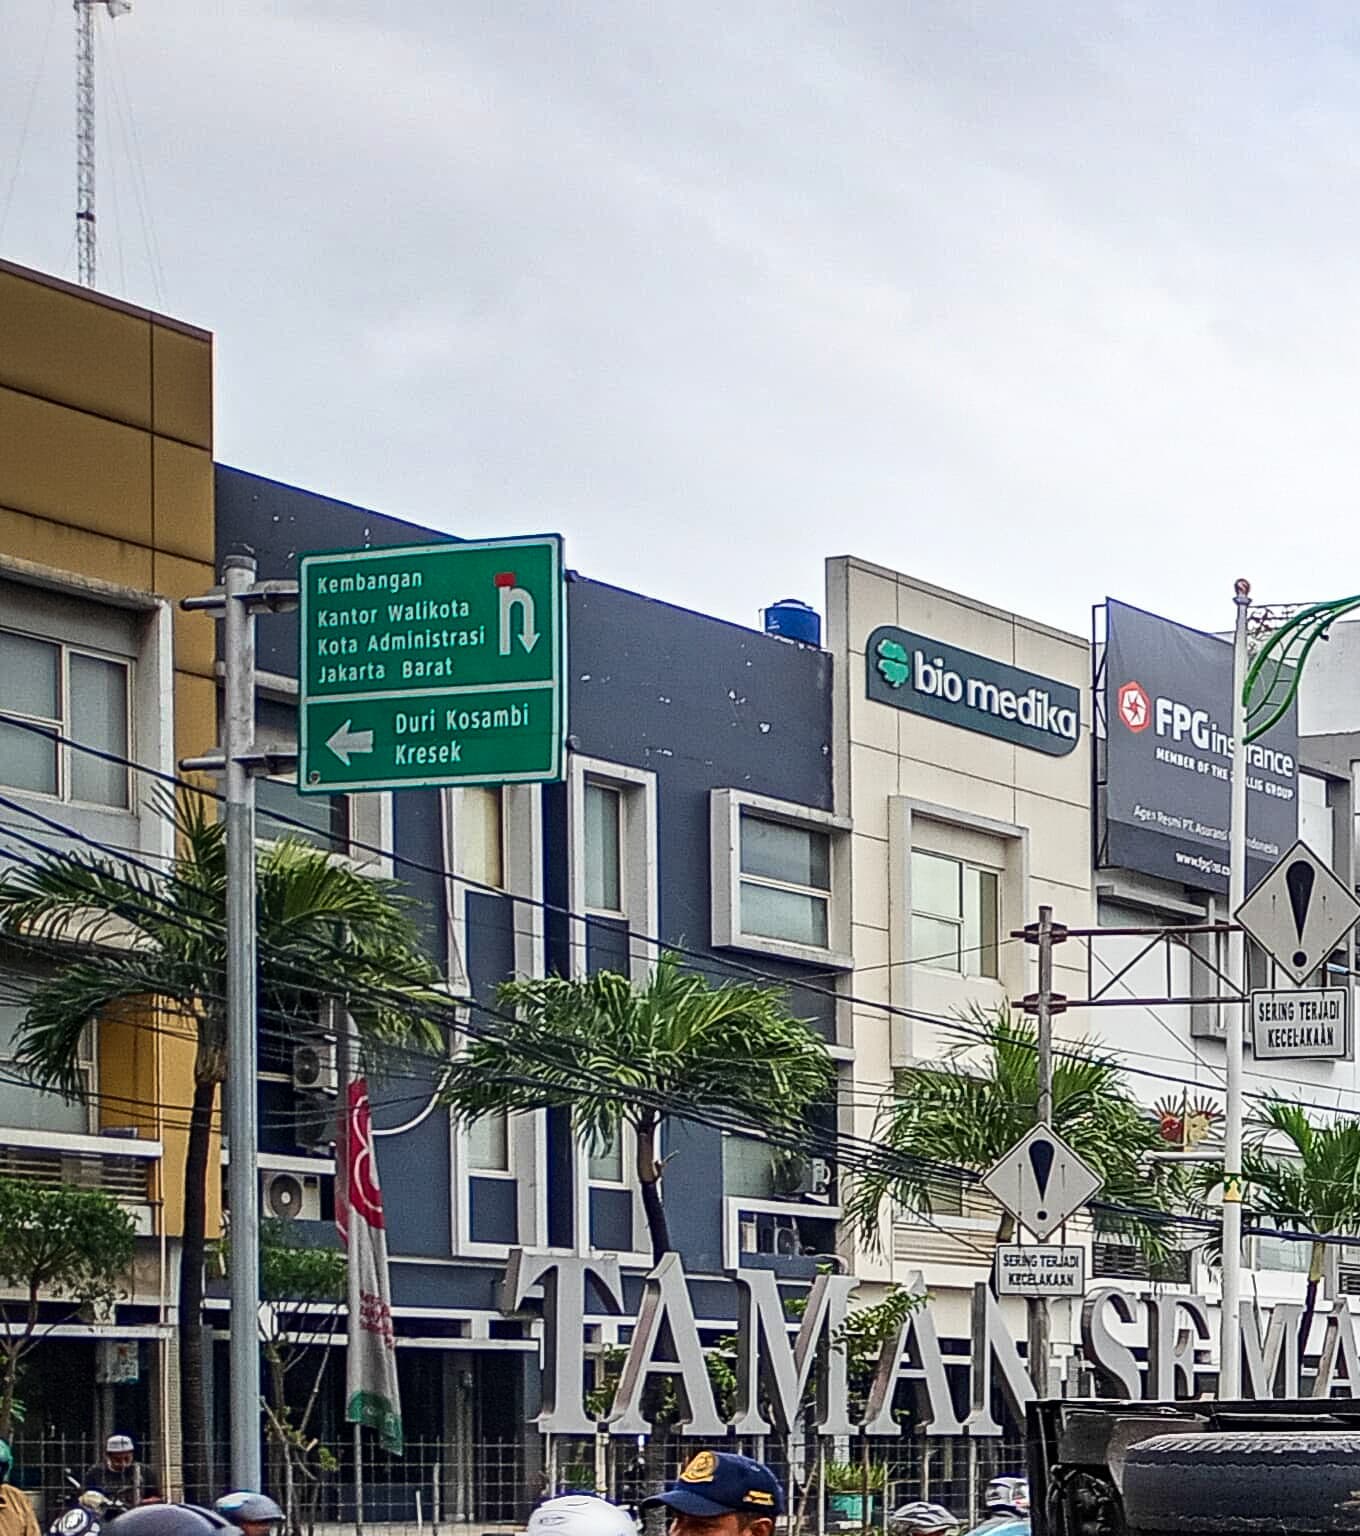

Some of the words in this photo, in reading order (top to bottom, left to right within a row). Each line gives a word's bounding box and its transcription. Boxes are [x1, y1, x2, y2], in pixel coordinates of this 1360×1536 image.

[317, 572, 422, 594] Kembangan
[317, 608, 377, 628] Kantor
[388, 600, 469, 622] Walikota
[318, 636, 357, 656] Kota
[368, 625, 485, 652] Administrasi
[318, 663, 385, 684] Jakarta
[402, 657, 453, 679] Barat
[913, 650, 963, 702] bio
[966, 678, 1077, 740] medika
[395, 709, 435, 734] Duri
[446, 703, 529, 731] Kosambi
[1155, 697, 1209, 750] FPG
[1211, 723, 1294, 777] insrance
[395, 741, 461, 765] Kresek
[1156, 748, 1195, 771] MEMBER
[1197, 762, 1210, 775] OF
[1211, 765, 1228, 781] THE
[1265, 780, 1294, 800] GROUP
[1258, 1002, 1295, 1022] SERING
[1299, 1000, 1340, 1021] TERJADI
[1267, 1027, 1334, 1048] KECELAKAAN
[1003, 1254, 1037, 1268] SERING
[1040, 1254, 1079, 1268] TERJADI
[1008, 1272, 1074, 1286] KECELAKAAN
[502, 1250, 1045, 1436] TAMAN
